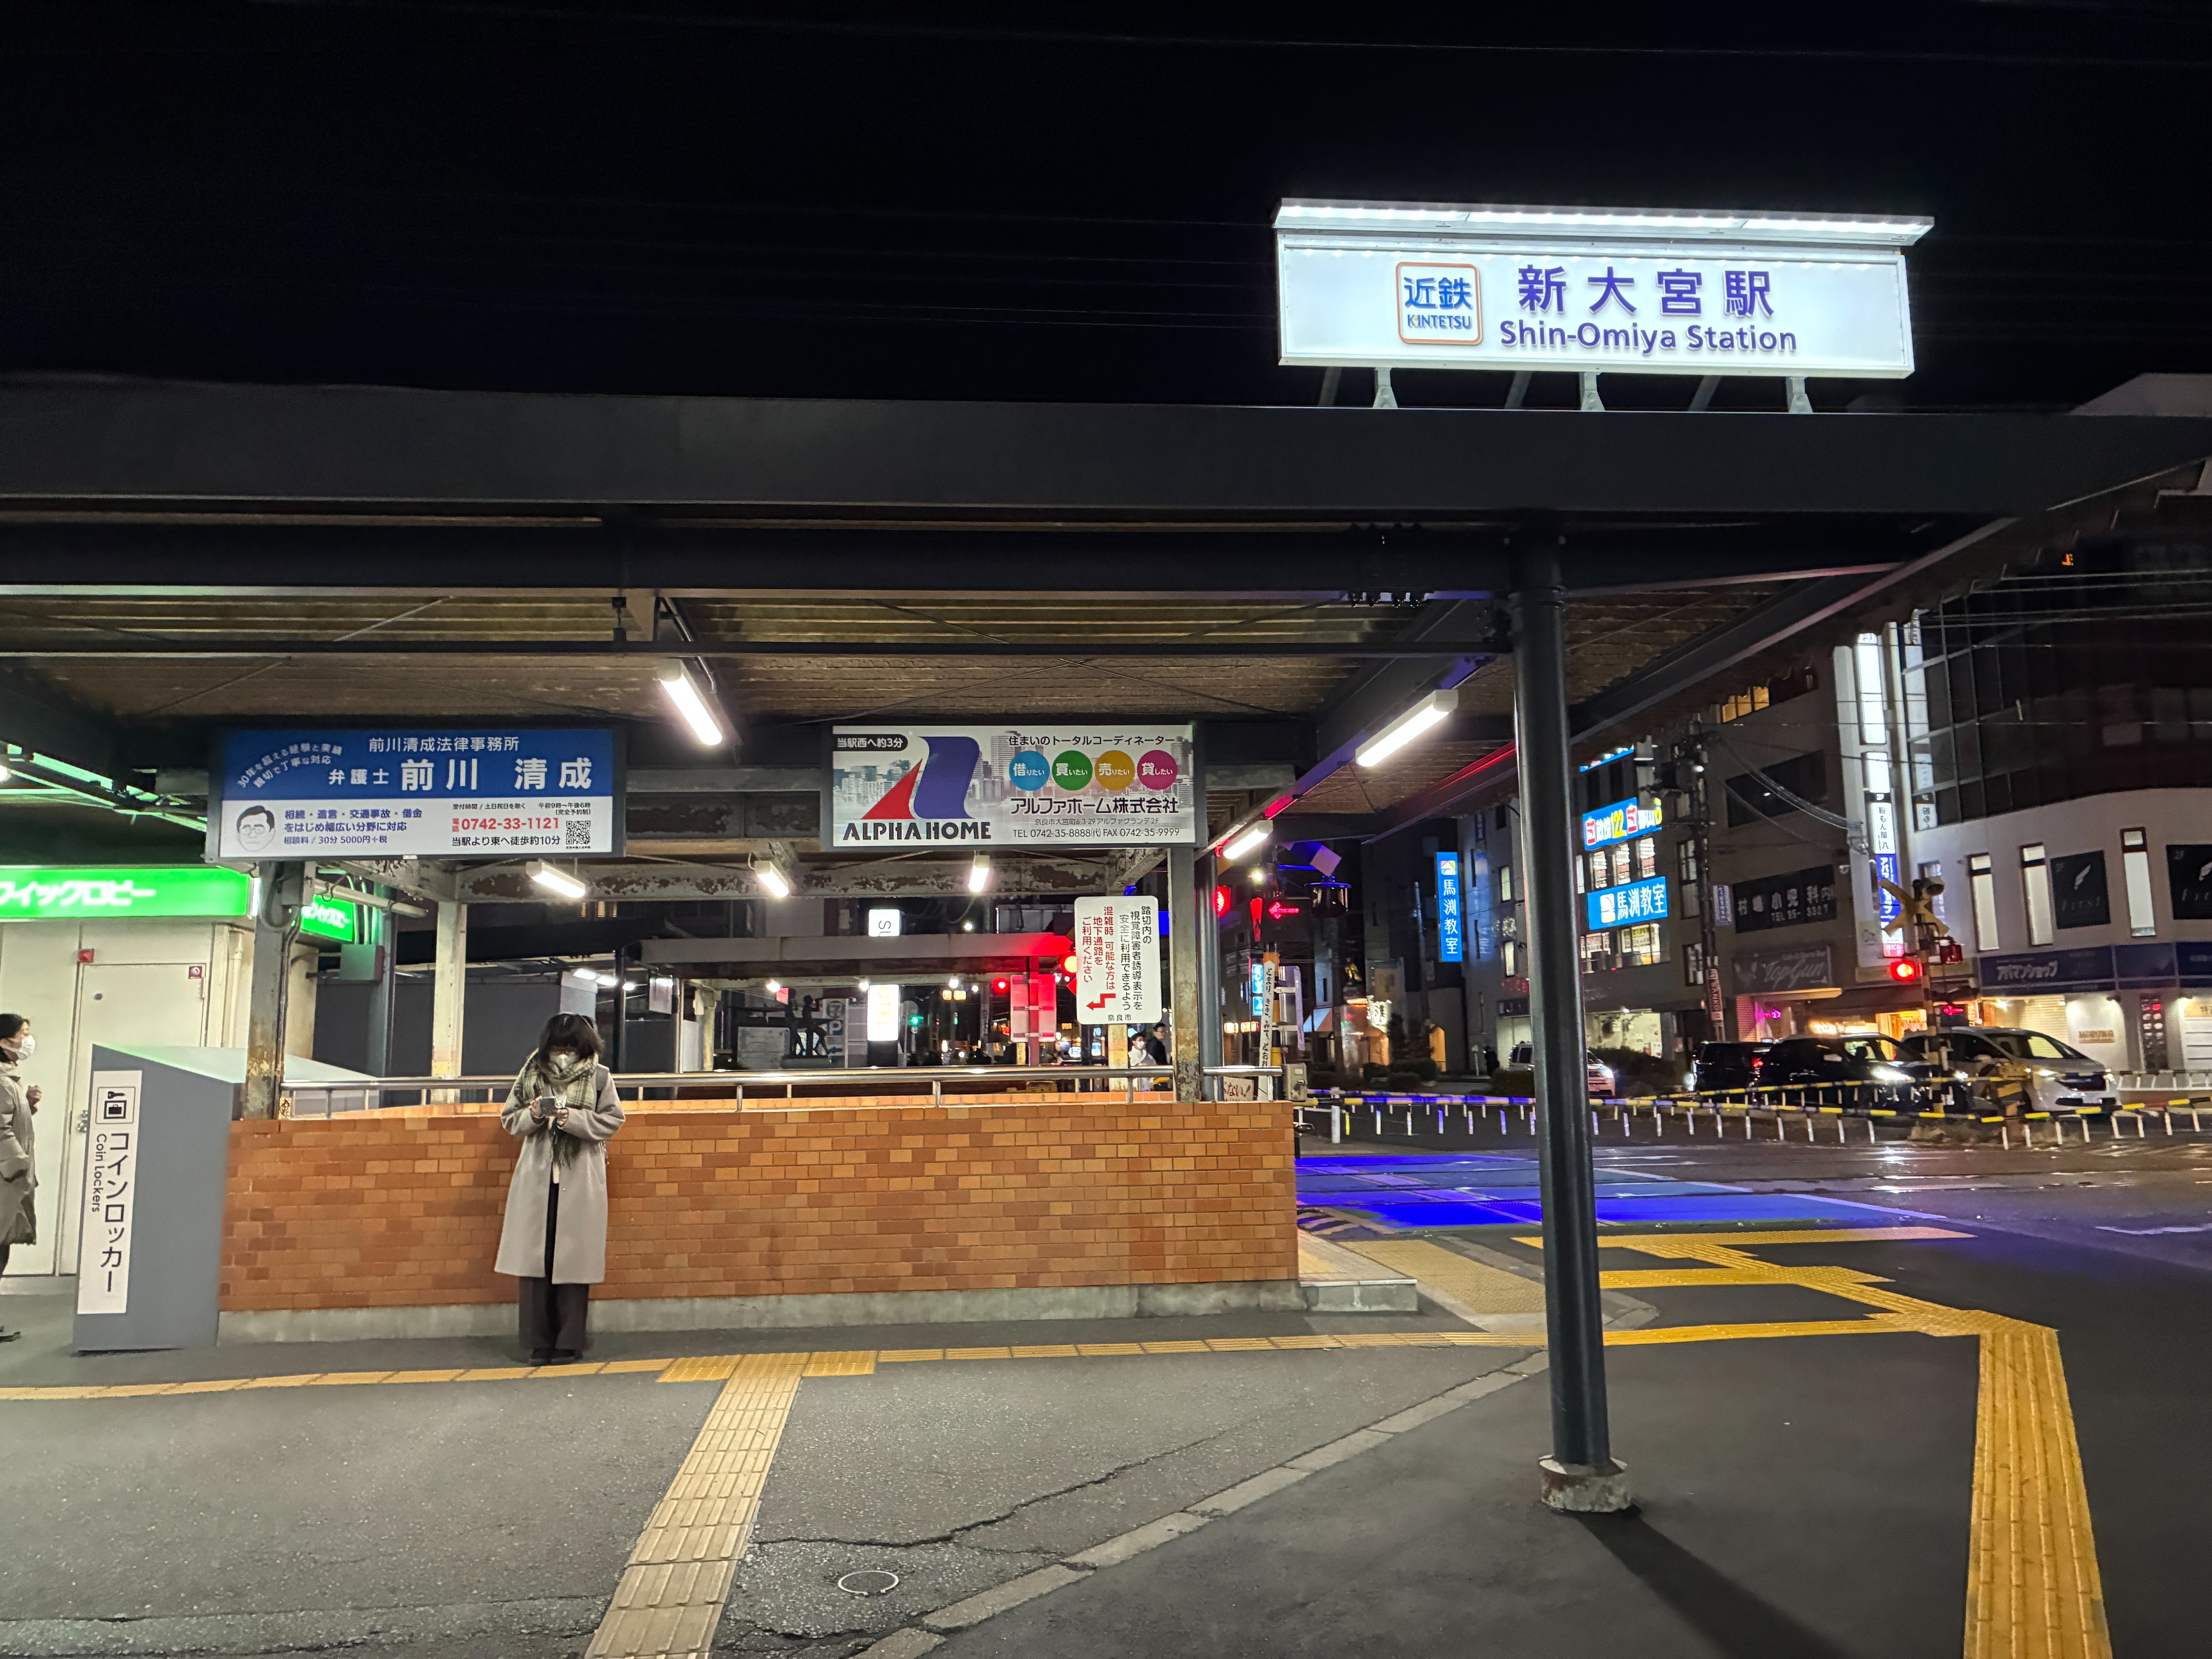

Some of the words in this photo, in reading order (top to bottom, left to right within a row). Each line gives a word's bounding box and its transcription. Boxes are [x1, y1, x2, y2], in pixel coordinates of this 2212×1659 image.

[1405, 277, 1472, 310] 近鉄
[1518, 264, 1774, 318] 新大宮駅
[1407, 313, 1472, 330] KINTETSU
[1500, 320, 1676, 356] Shin-Omiya
[1685, 325, 1797, 351] Station
[369, 737, 519, 752] 前川清成法律事務所
[837, 737, 903, 748] 当駅西へ約3分
[1009, 735, 1175, 746] 住まいのトータルコーディネーター
[328, 768, 389, 785] 弁護士
[400, 758, 478, 791] 前川
[514, 757, 592, 790] 清成
[1013, 763, 1045, 776] 借りたい
[1056, 763, 1088, 776] 買いたい
[1099, 763, 1130, 776] 売りたい
[1142, 762, 1173, 776] 貸したい
[1010, 797, 1179, 814] アルファホーム株式会社
[284, 821, 407, 832] をはじめ幅広い分野に対応
[462, 817, 559, 830] 0742-33-1121
[843, 823, 922, 840] ALPHA
[926, 822, 991, 840] HOME
[1013, 830, 1028, 838] TEL
[1103, 828, 1117, 836] FAX
[1120, 828, 1180, 837] 0742-35-9999
[452, 836, 561, 846] 当駅より東へ徒歩約10分
[1443, 879, 1458, 954] 馬渕教室
[1617, 883, 1666, 921] 馬渕教室
[1104, 906, 1114, 936] 混雑時
[1141, 906, 1152, 944] 踏切内の
[1082, 916, 1093, 983] ご利用ください
[1093, 916, 1103, 965] 地下通路を
[1104, 941, 1116, 990] 可能な方は
[1120, 914, 1131, 1010] 安全に利用できるよう
[1130, 911, 1143, 1010] 視覚障害者誘導表示を
[829, 1020, 843, 1035] P
[95, 1133, 107, 1162] Coin
[91, 1166, 105, 1212] Lockers
[100, 1133, 129, 1292] コインロッカー
